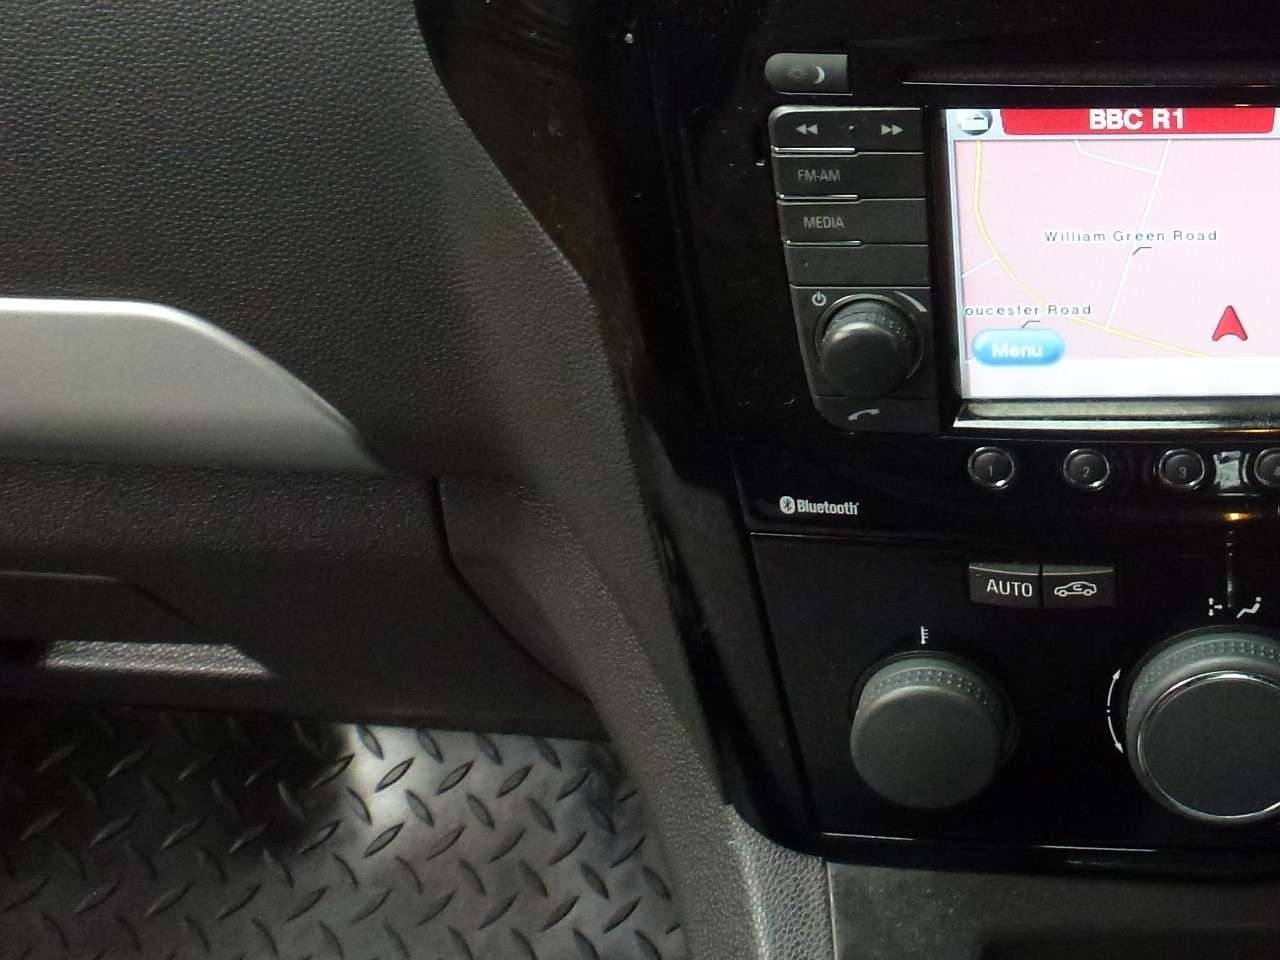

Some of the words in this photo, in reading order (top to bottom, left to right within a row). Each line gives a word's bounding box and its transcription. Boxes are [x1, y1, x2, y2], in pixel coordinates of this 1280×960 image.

[1088, 107, 1144, 130] BBC
[1152, 107, 1185, 130] R1
[797, 168, 841, 182] FM-AM
[803, 216, 845, 229] MEDIA
[1044, 230, 1107, 242] William
[1112, 230, 1166, 242] Green
[1172, 229, 1218, 241] Road
[1048, 303, 1092, 316] Road
[991, 341, 1044, 358] Menu
[796, 498, 858, 515] Bluetooth
[986, 578, 1034, 598] AUTO
